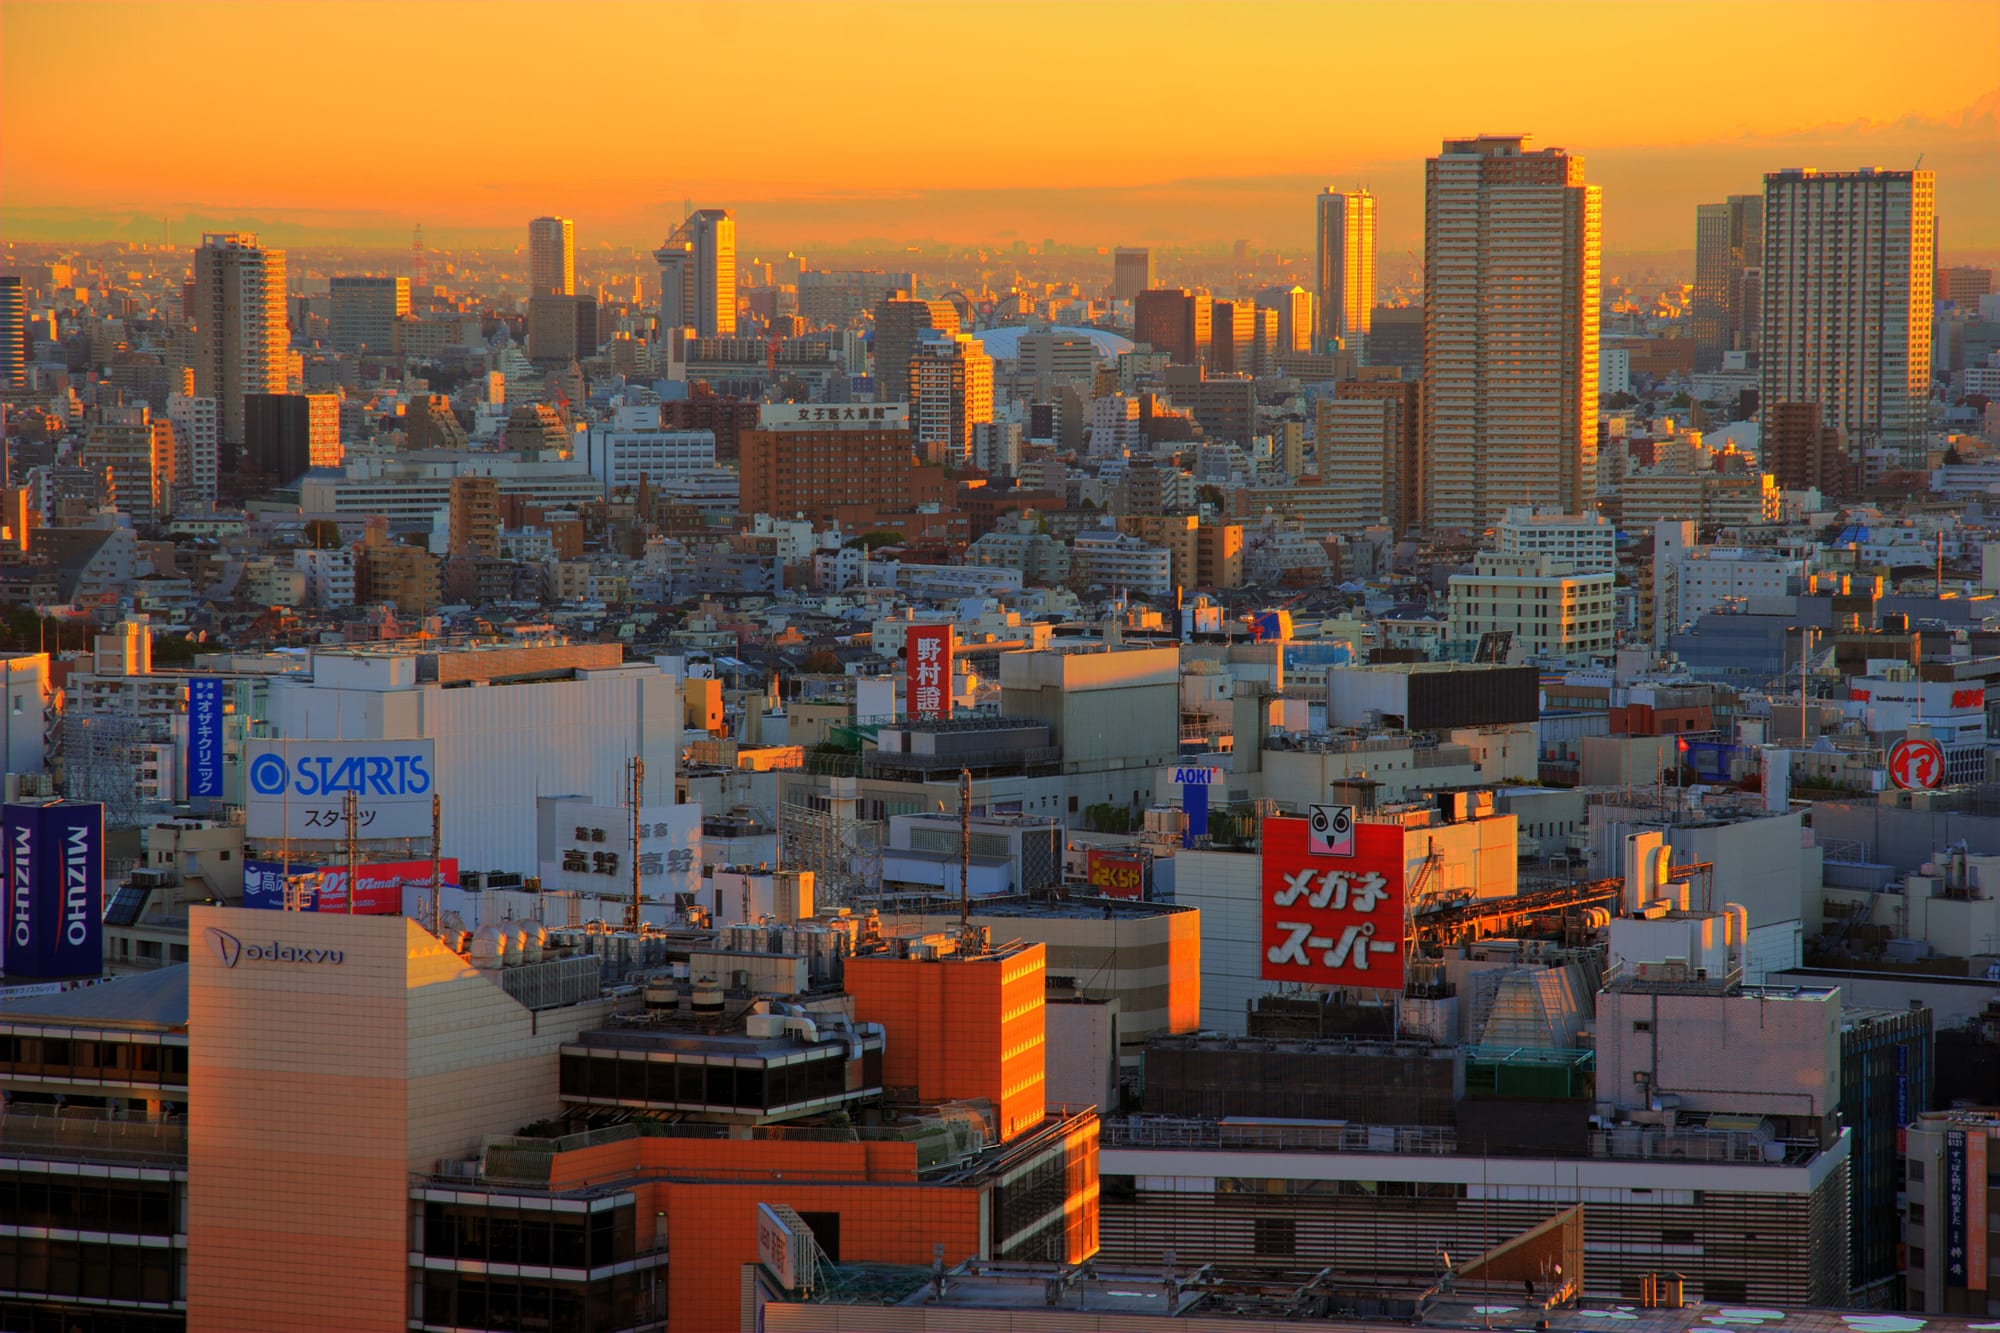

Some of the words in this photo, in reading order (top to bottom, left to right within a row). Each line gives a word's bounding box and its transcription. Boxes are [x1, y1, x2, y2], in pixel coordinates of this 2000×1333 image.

[197, 701, 213, 794] オザキクリニック
[295, 755, 430, 796] STARTS
[1174, 767, 1212, 784] AOKI
[305, 810, 376, 828] スターツ
[15, 826, 31, 947] MIZUHO
[67, 825, 88, 946] MIZUHO
[1273, 868, 1391, 913] メガネ
[247, 940, 344, 965] odakyu
[1266, 920, 1397, 971] スーパー
